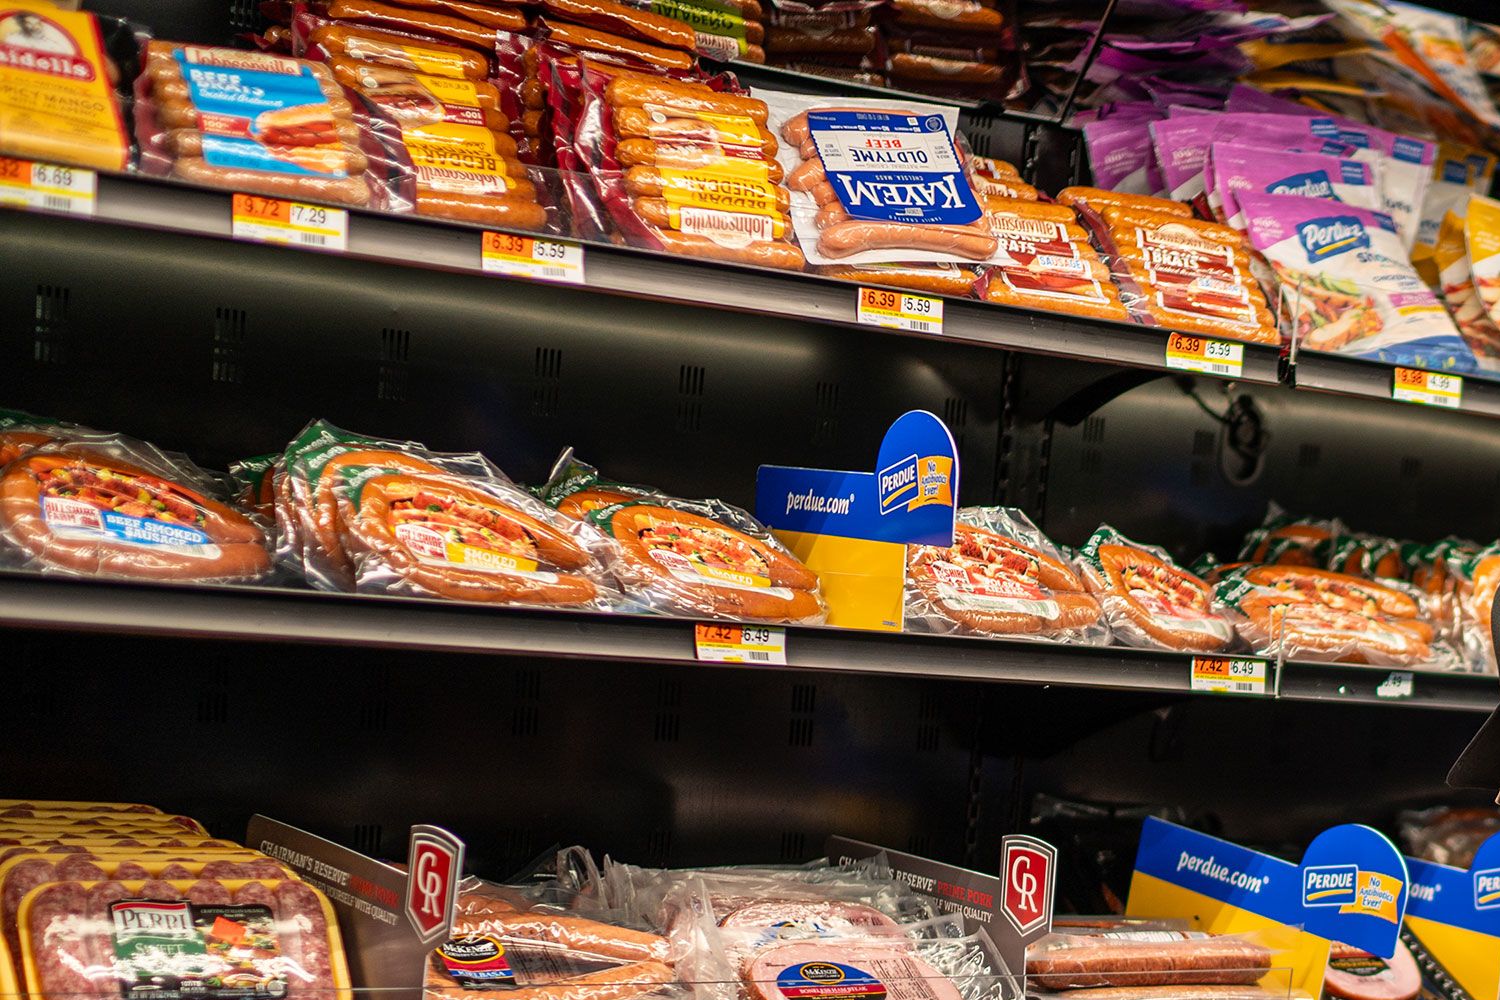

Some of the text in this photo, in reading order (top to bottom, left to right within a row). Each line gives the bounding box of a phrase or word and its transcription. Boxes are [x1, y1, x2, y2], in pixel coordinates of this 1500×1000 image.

[864, 138, 902, 149] BEEF
[849, 149, 928, 164] OLD TYME
[836, 172, 966, 209] KAYEM
[685, 214, 770, 238] Johnsonville
[1302, 219, 1366, 249] Perdue
[1039, 255, 1082, 270] SAUSAGE
[927, 460, 936, 472] No
[882, 465, 916, 494] PERDUE
[921, 473, 947, 485] Antibiotics
[923, 484, 938, 496] Ever!
[47, 511, 78, 524] FARM
[106, 514, 202, 543] BEEF SMOKED
[465, 547, 518, 568] SMOKED
[260, 840, 313, 871] CHAIRMAN'S
[1307, 872, 1354, 889] PERDUE
[1370, 876, 1381, 888] No
[937, 881, 966, 899] PRIME
[967, 888, 993, 908] PORK
[1359, 887, 1394, 903] Antibiotics
[1361, 896, 1382, 908] Ever!
[355, 896, 372, 913] WITH
[370, 903, 400, 926] QUALITY
[944, 901, 993, 924] WITH QUALITY
[804, 967, 838, 976] McKENZIE
[799, 986, 831, 994] BONELESS
